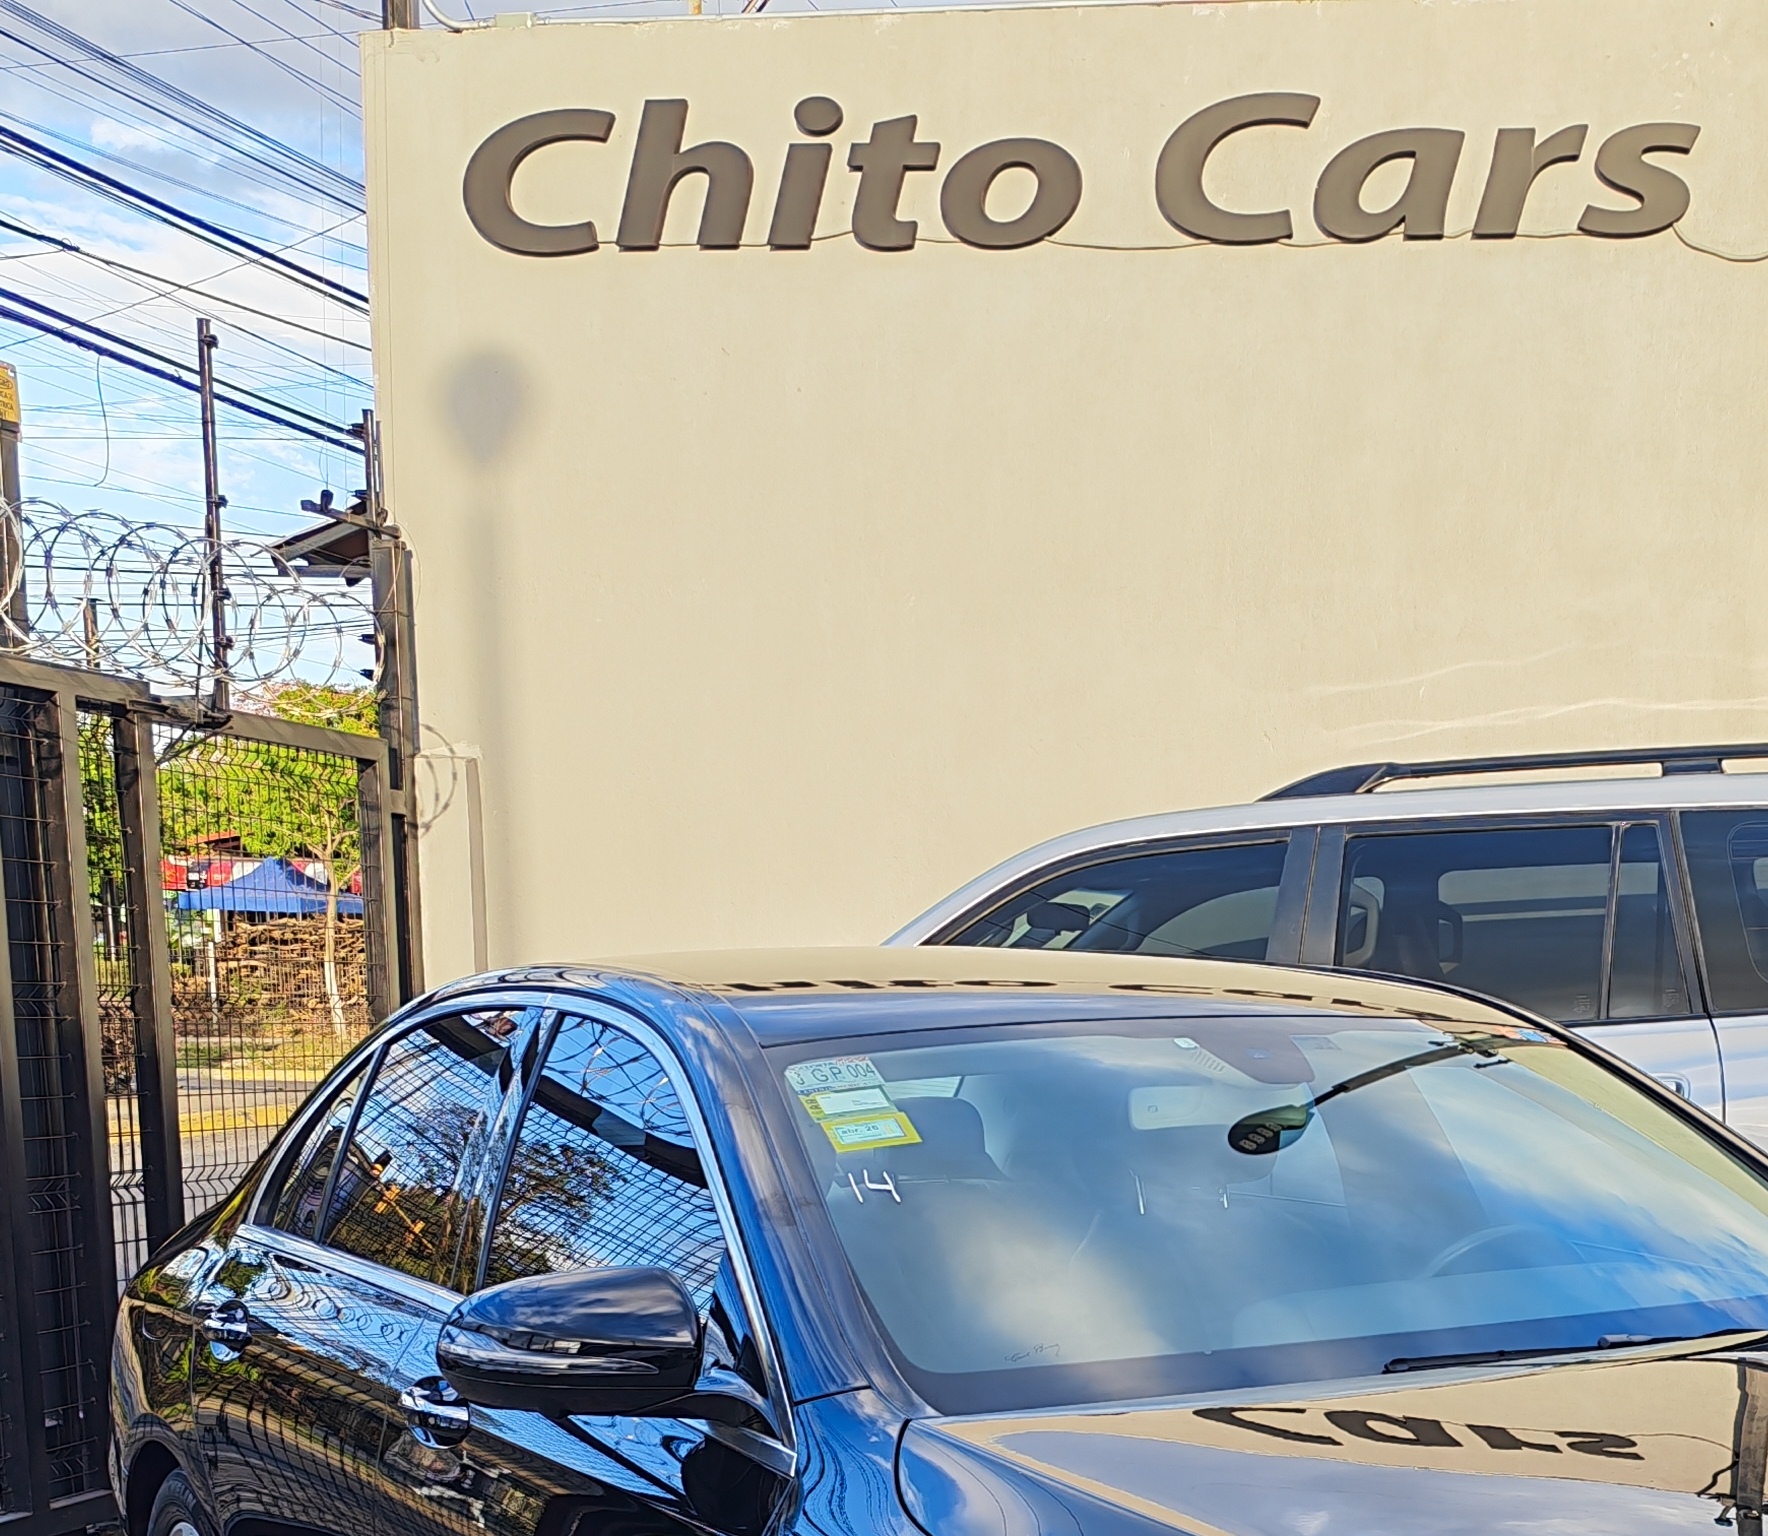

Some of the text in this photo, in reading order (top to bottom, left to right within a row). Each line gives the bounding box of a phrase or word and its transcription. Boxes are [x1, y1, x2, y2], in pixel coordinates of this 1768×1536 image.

[461, 91, 1703, 256] Chito Cars
[847, 1168, 902, 1204] 14
